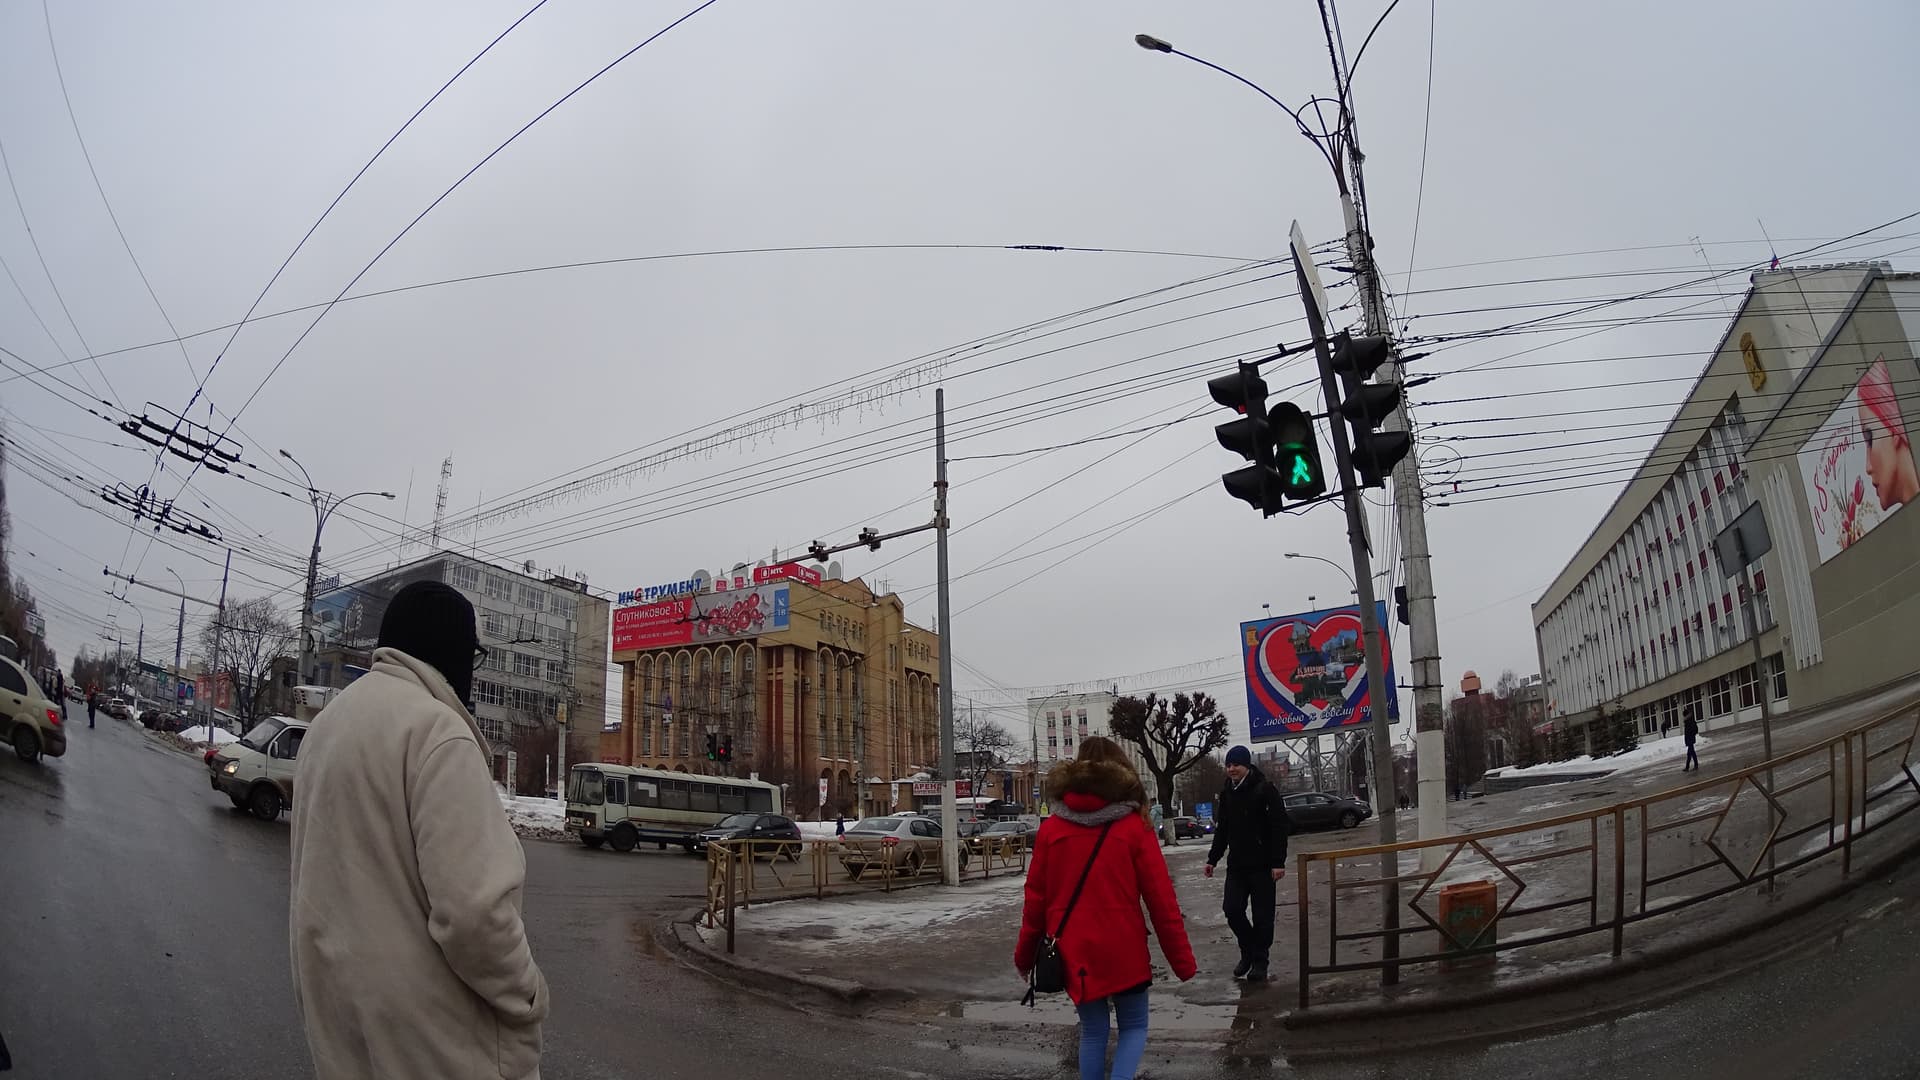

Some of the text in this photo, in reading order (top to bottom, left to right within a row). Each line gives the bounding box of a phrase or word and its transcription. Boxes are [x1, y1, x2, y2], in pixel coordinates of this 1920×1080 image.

[770, 567, 784, 575] МТС
[616, 606, 671, 624] Спутниковое
[1263, 711, 1305, 727] любовью
